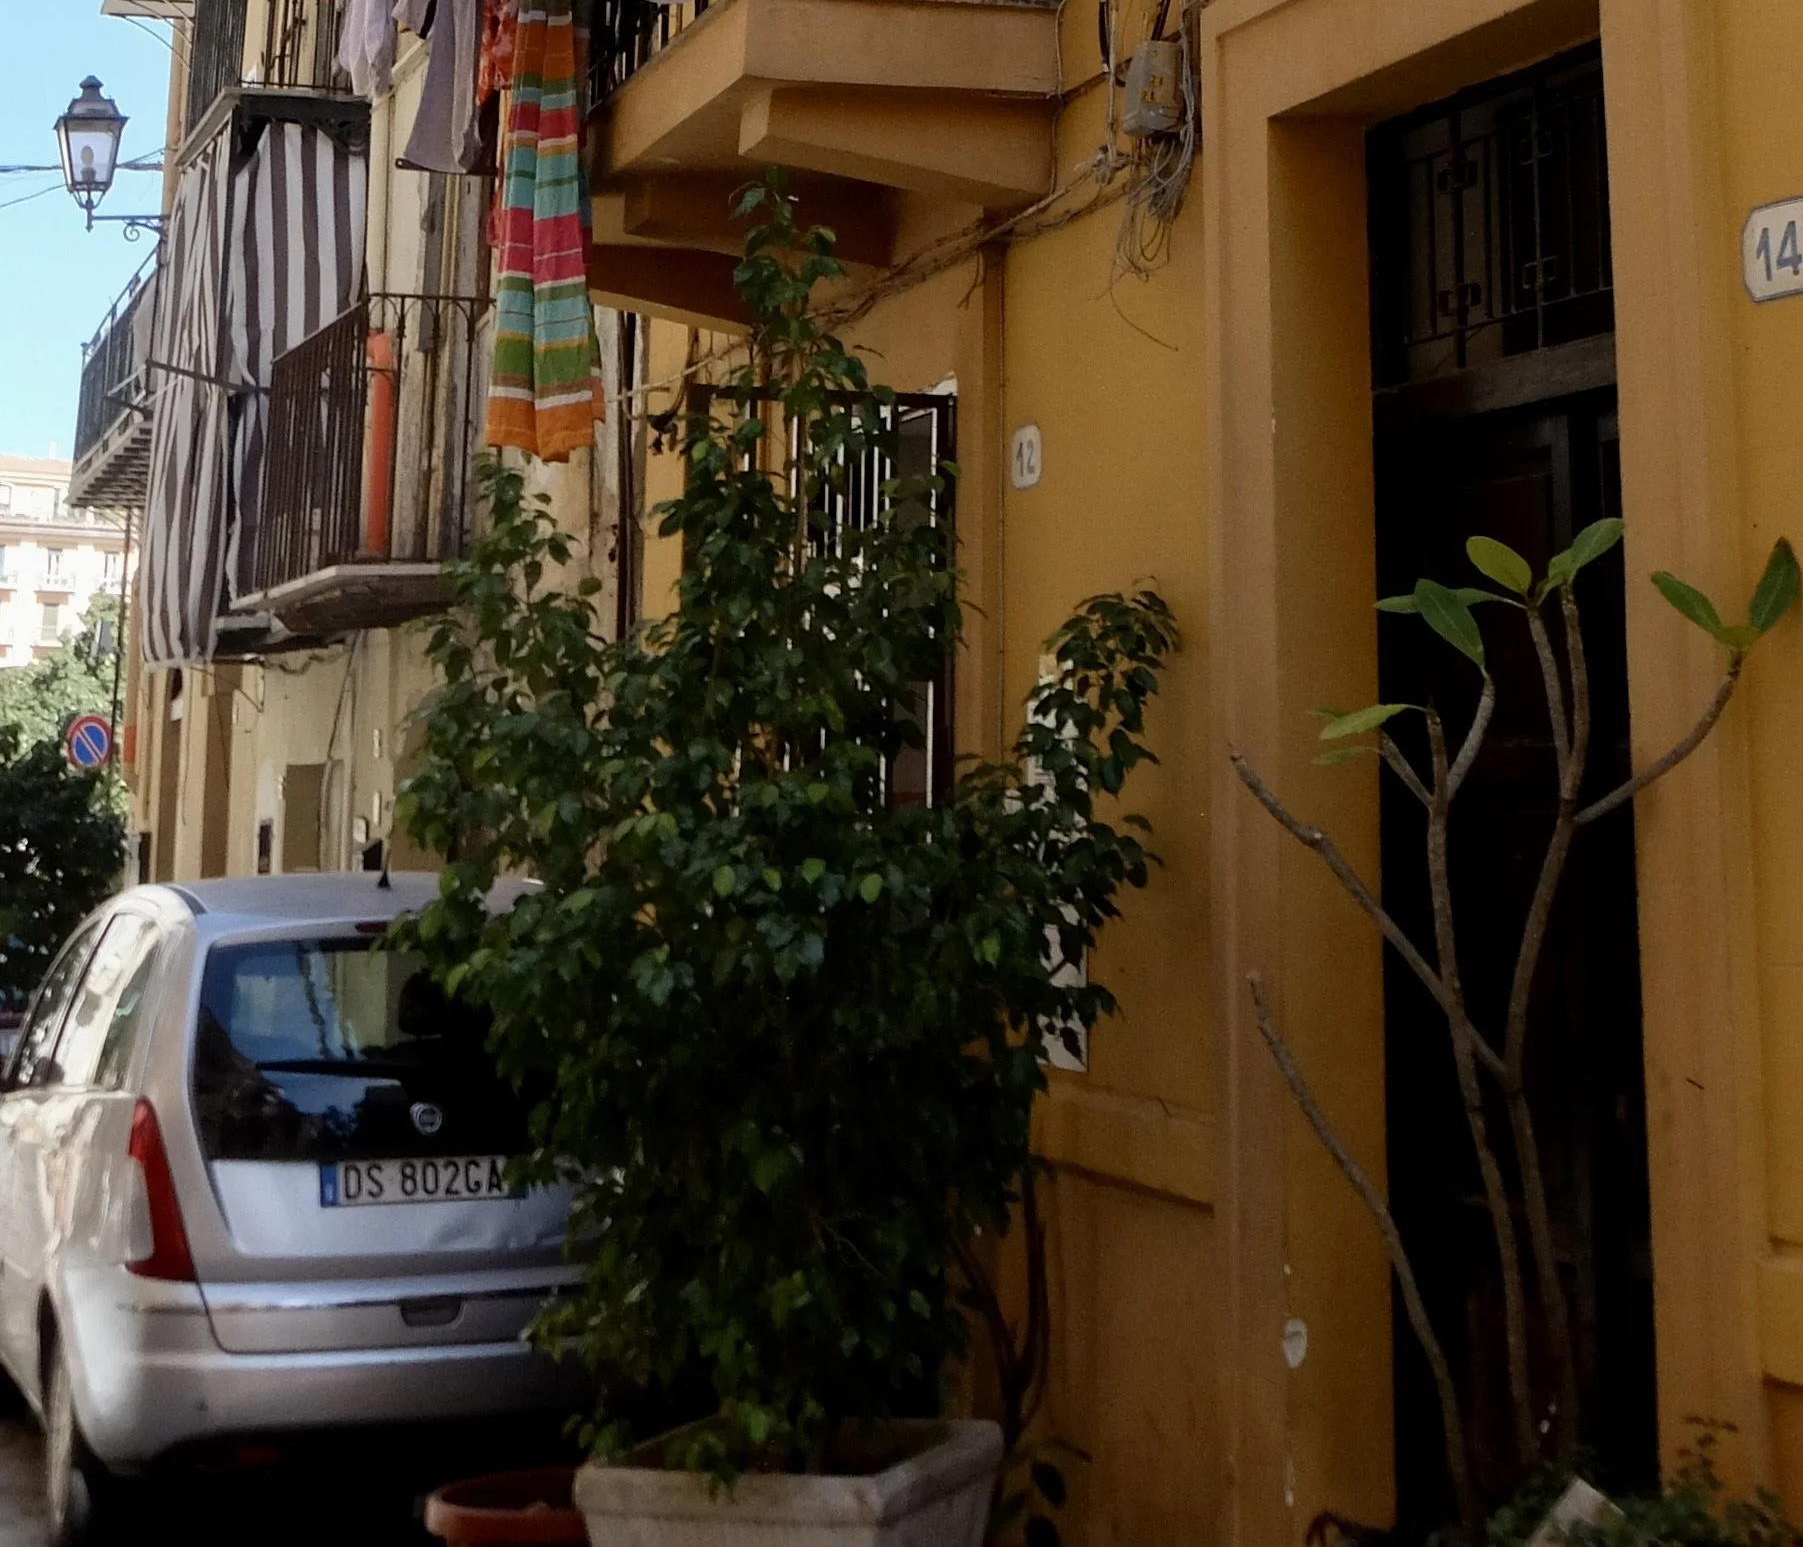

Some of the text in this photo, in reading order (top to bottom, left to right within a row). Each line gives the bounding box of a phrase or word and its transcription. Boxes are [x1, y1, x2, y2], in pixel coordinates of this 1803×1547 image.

[1756, 220, 1803, 281] 14
[1015, 438, 1035, 477] 12
[344, 1163, 383, 1200] DS
